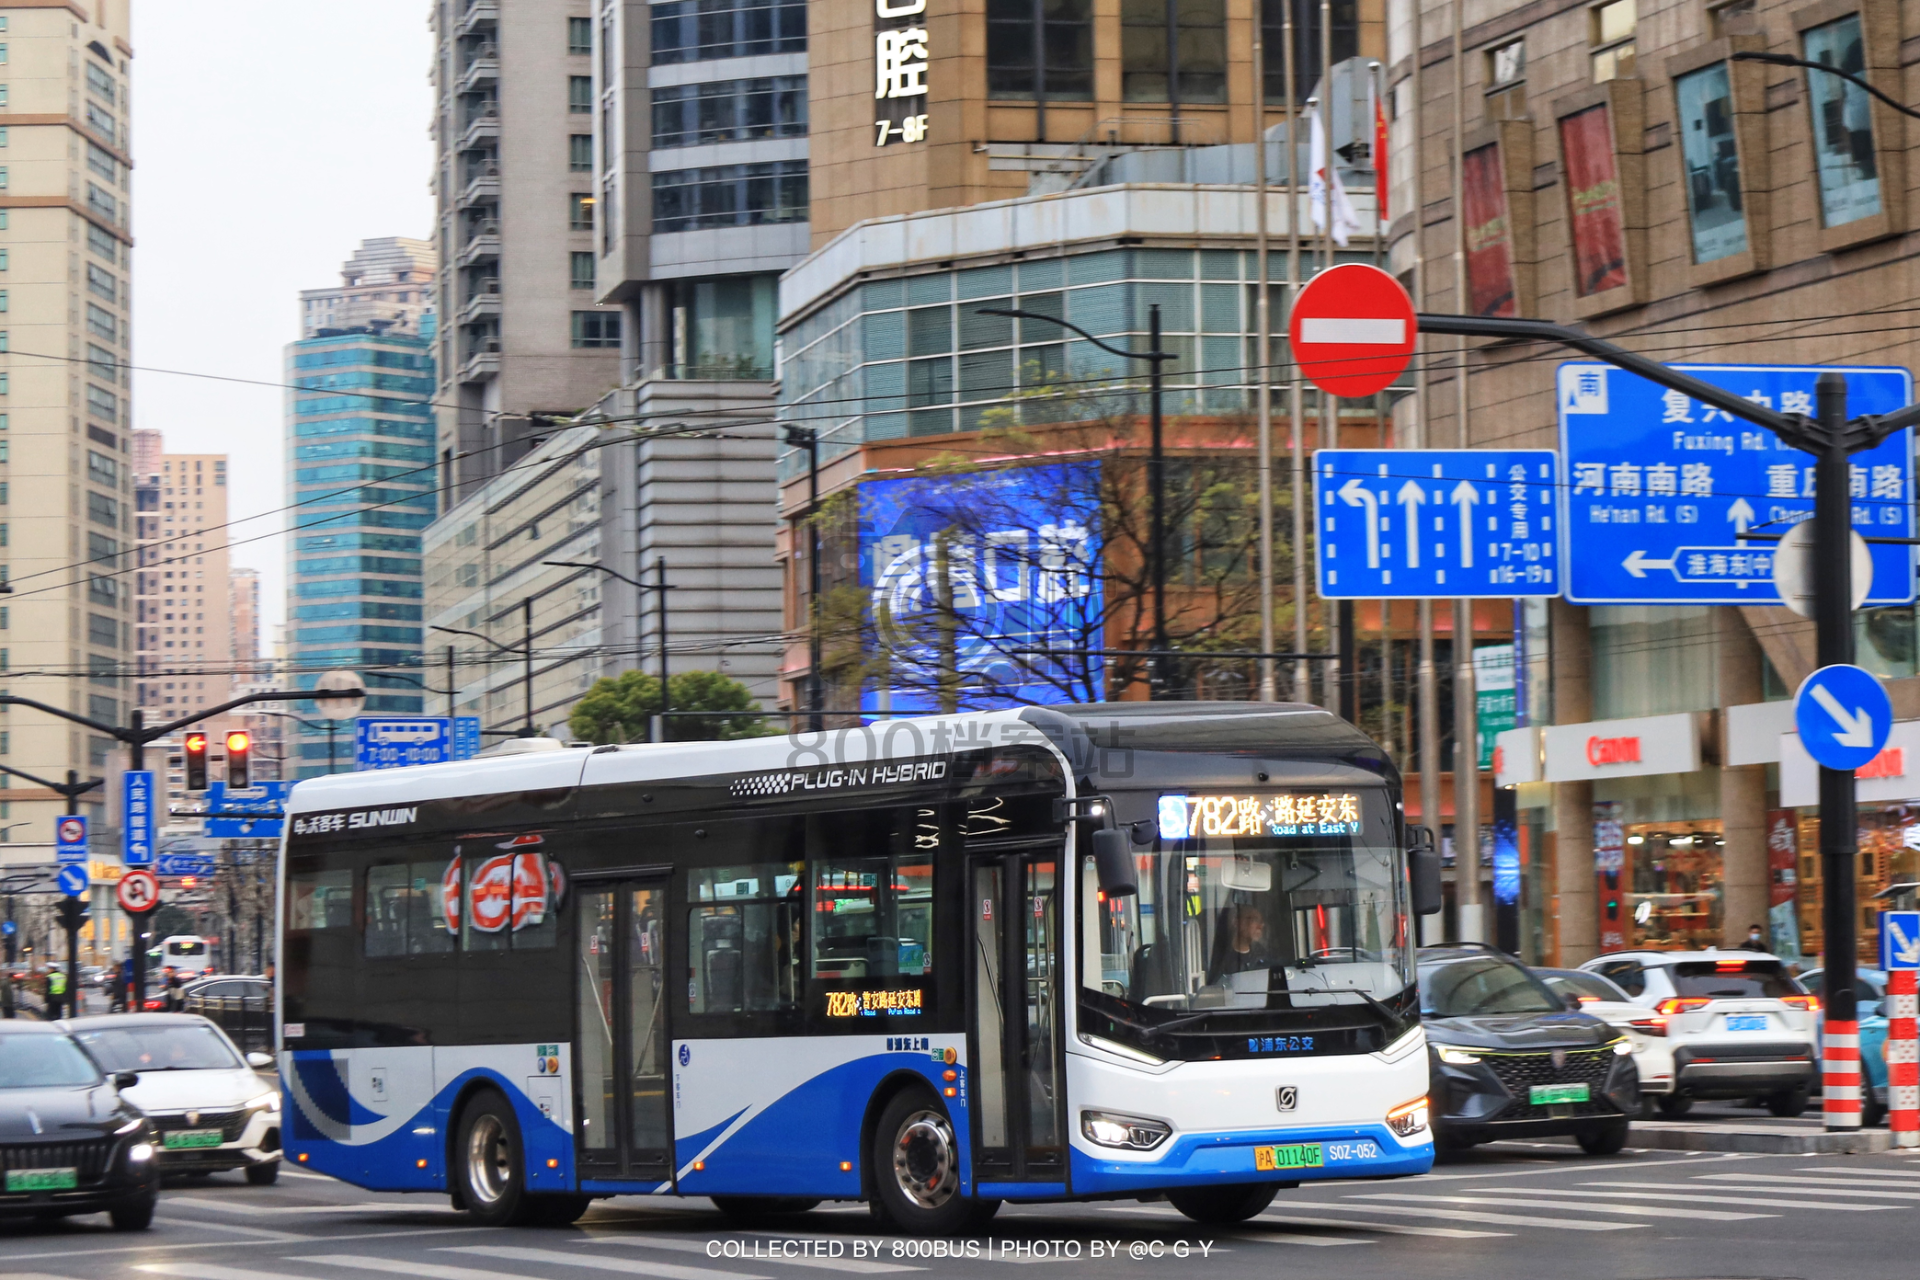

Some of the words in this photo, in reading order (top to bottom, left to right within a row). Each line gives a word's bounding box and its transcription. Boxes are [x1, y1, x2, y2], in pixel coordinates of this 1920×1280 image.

[875, 114, 929, 147] 7-8F
[1577, 371, 1601, 397] 南
[1672, 430, 1735, 456] Fuxing
[1740, 431, 1768, 451] Rd.
[1571, 461, 1715, 498] 河南南路
[1507, 463, 1529, 539] 公交专用
[1645, 504, 1670, 524] Rd.
[1674, 504, 1699, 524] (S)
[1850, 506, 1874, 525] Rd.
[1879, 506, 1903, 525] (S)
[1499, 542, 1540, 562] 7-10
[1497, 564, 1544, 584] 16-19
[1586, 736, 1642, 767] Canon
[790, 765, 869, 791] PLUG-IN
[871, 760, 947, 785] HYBRID
[129, 774, 148, 842] 人民路隧道
[347, 806, 418, 830] SUNWIN
[1186, 796, 1264, 836] 782路
[1272, 794, 1359, 825] 路延安东
[1301, 824, 1315, 835] at
[1319, 824, 1346, 834] East
[825, 991, 858, 1017] 782路
[1260, 1036, 1315, 1052] 浦东公交
